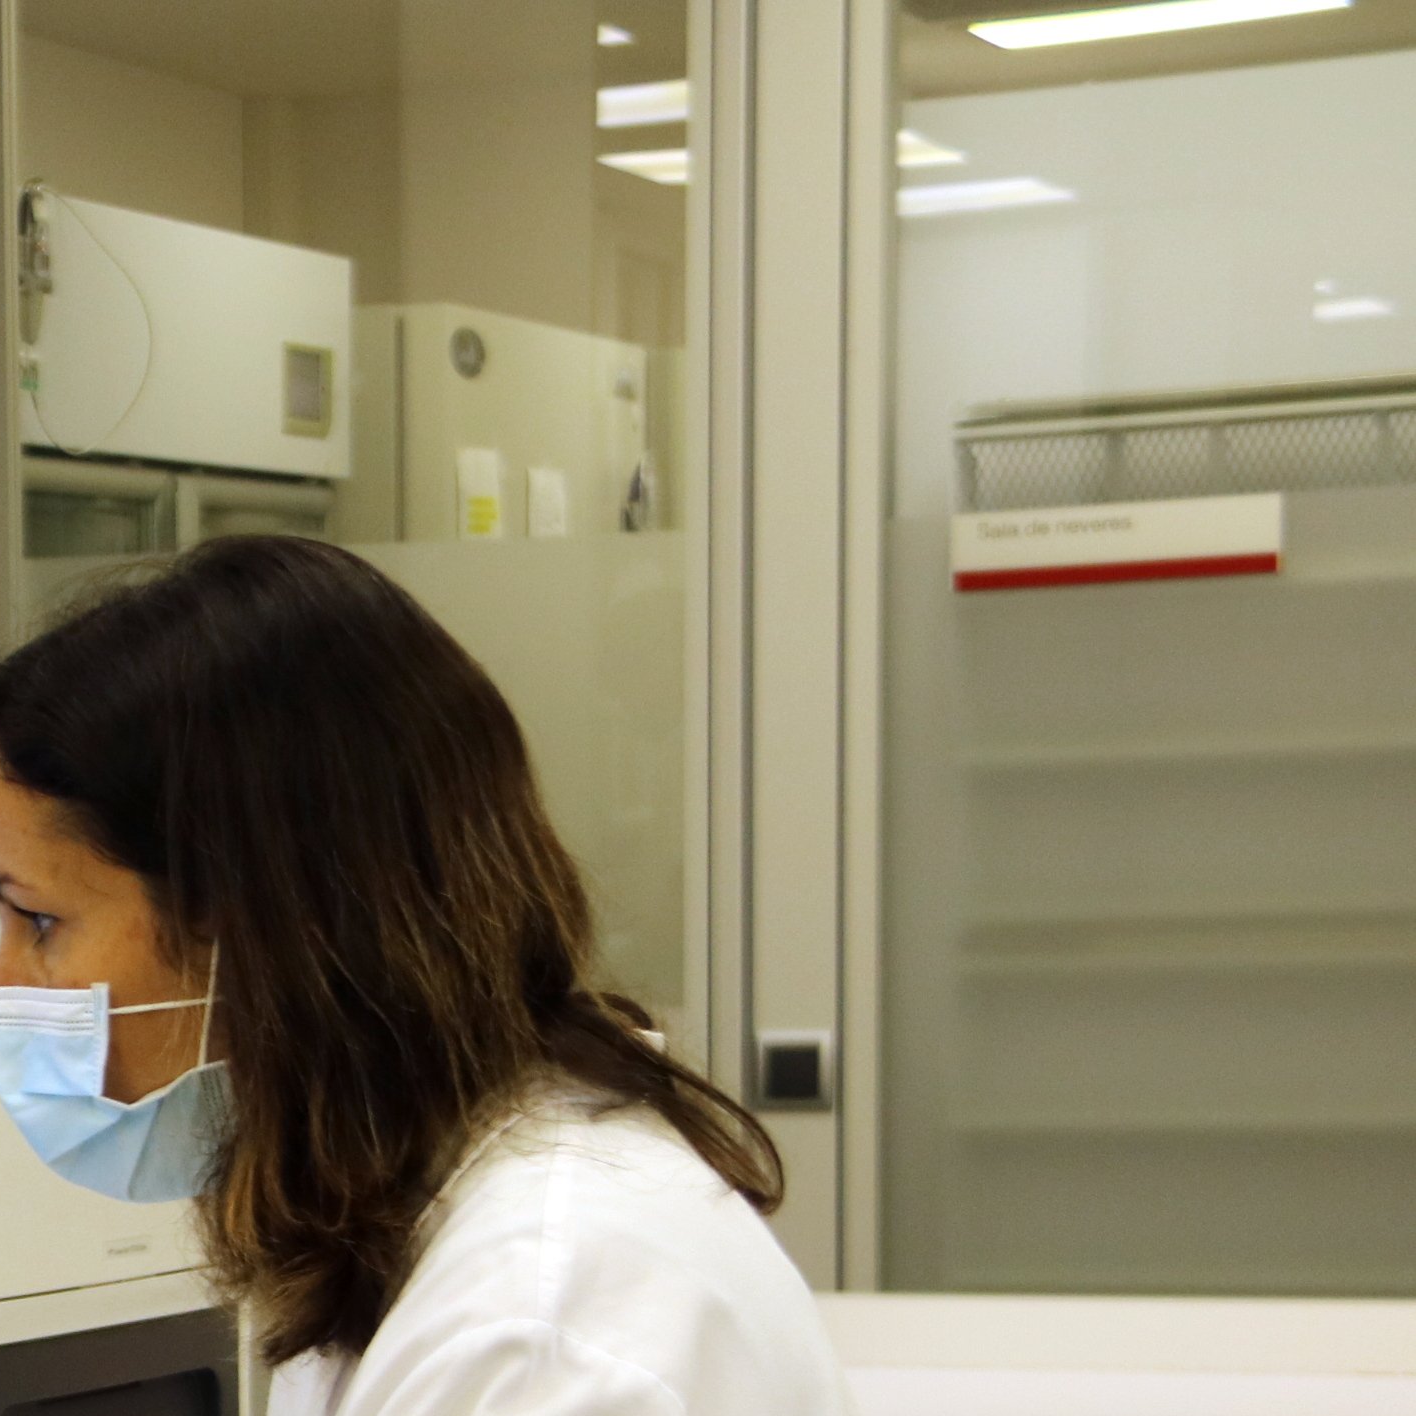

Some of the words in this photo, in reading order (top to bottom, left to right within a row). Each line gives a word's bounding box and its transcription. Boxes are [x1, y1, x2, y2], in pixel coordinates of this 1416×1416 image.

[976, 521, 1019, 541] Sala
[1024, 519, 1051, 537] de
[1055, 515, 1134, 536] neveres
